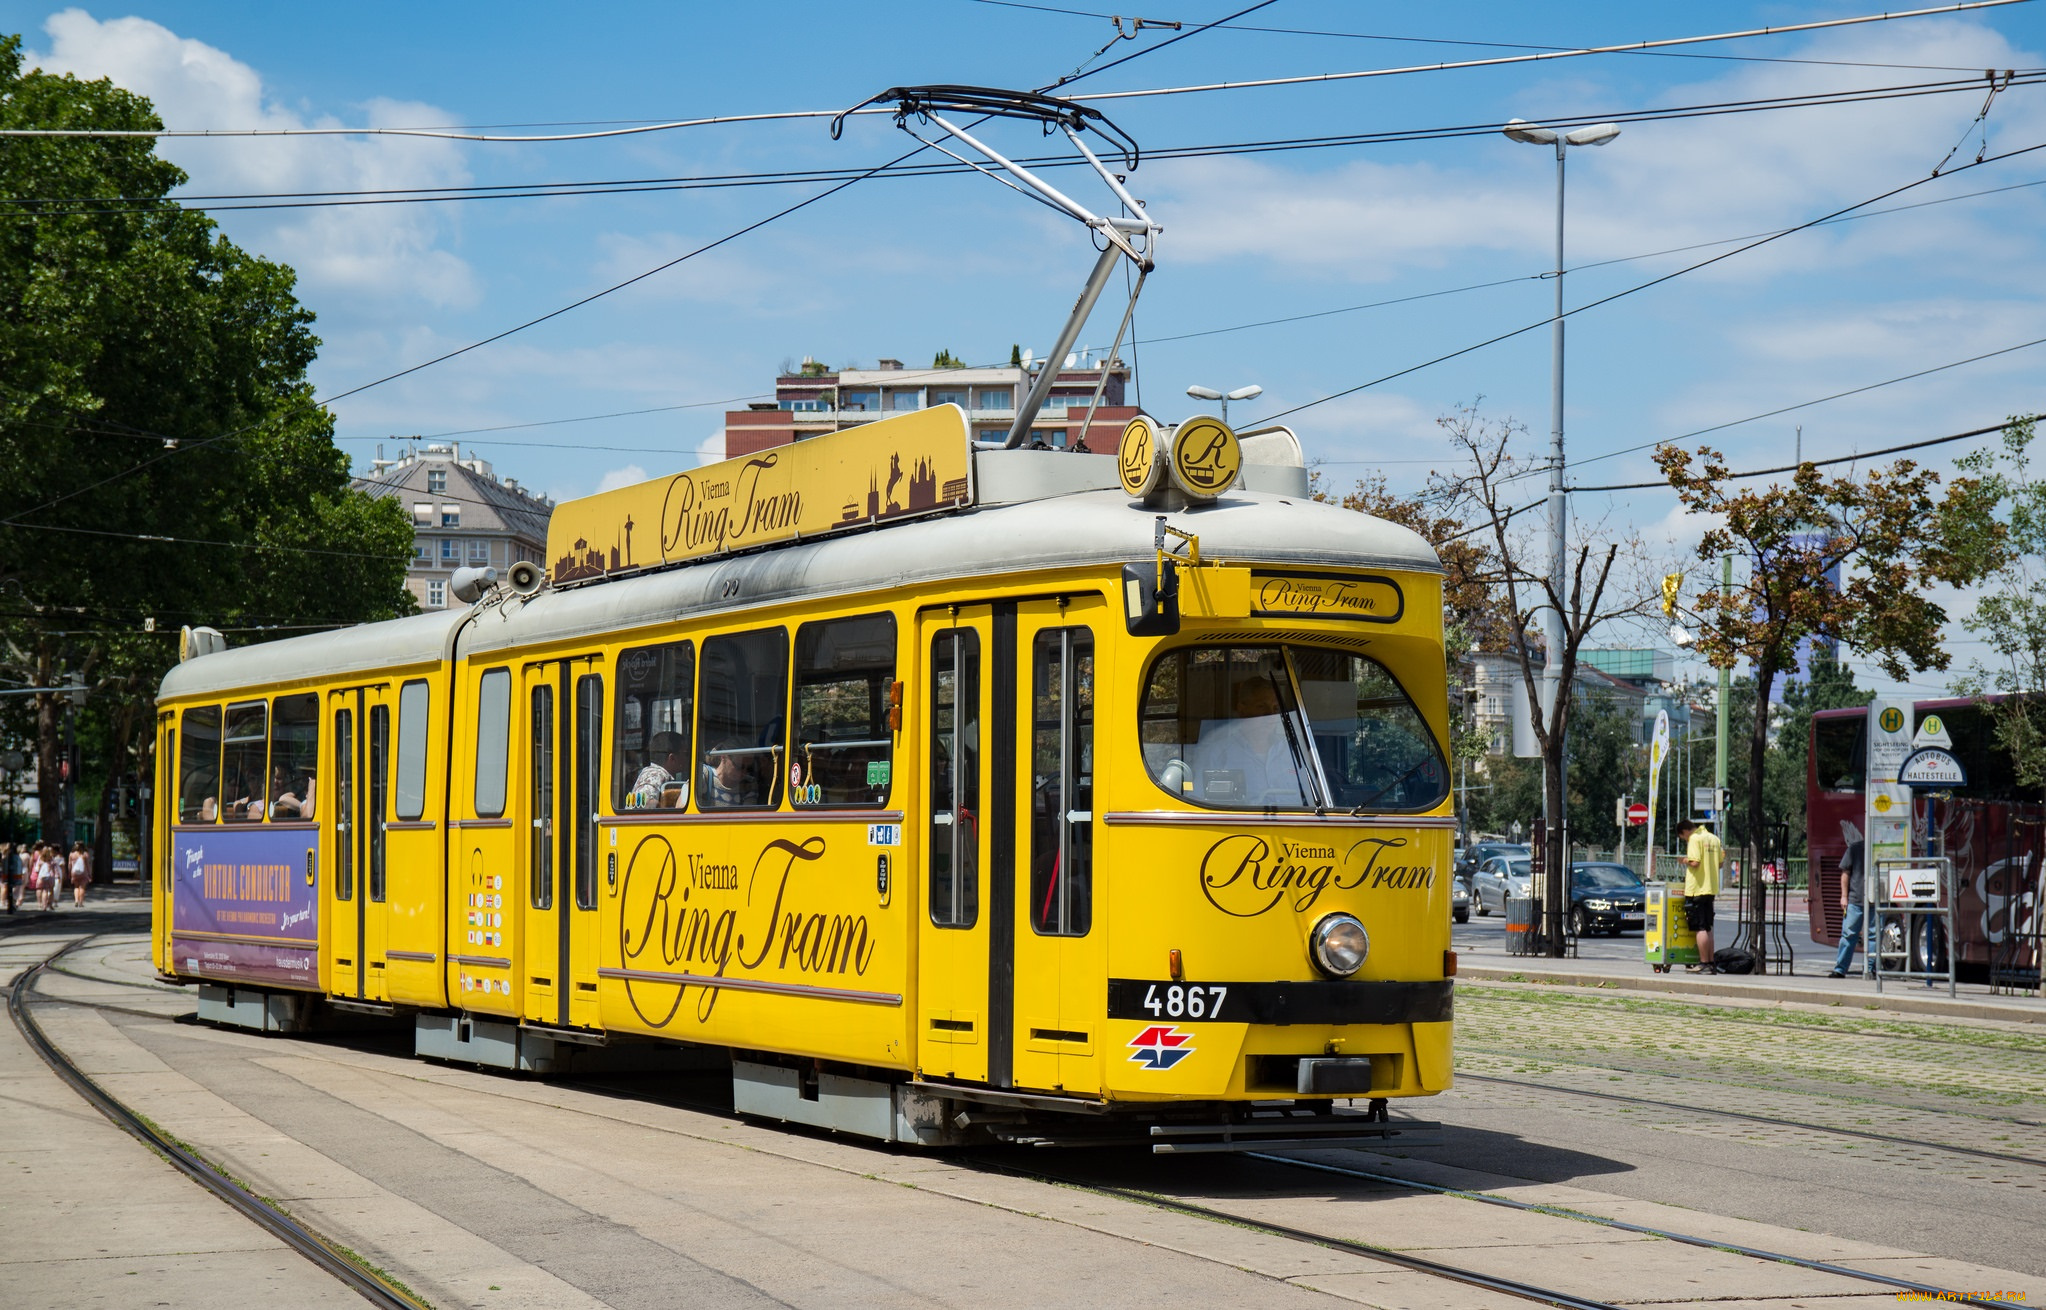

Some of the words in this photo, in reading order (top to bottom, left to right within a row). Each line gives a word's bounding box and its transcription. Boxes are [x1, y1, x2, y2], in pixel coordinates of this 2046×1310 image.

[700, 480, 730, 502] Vienna
[661, 474, 729, 566] Ring
[729, 453, 805, 539] Tram
[1260, 578, 1322, 612] Ring
[1322, 582, 1377, 611] Tram
[1297, 583, 1322, 592] Vienna
[1885, 712, 1898, 729] H
[1915, 751, 1952, 766] AUTOBUS
[1907, 772, 1957, 780] HALTESTELLE
[1282, 842, 1336, 859] Vienna
[204, 864, 237, 900] VIRTUAL
[240, 865, 291, 902] CONDUCTOR
[688, 853, 738, 890] Vienna
[1199, 834, 1333, 917] Ring
[1334, 837, 1436, 890] Tram
[620, 833, 737, 1028] Ring
[737, 836, 876, 976] Tram
[1143, 984, 1228, 1019] 4867
